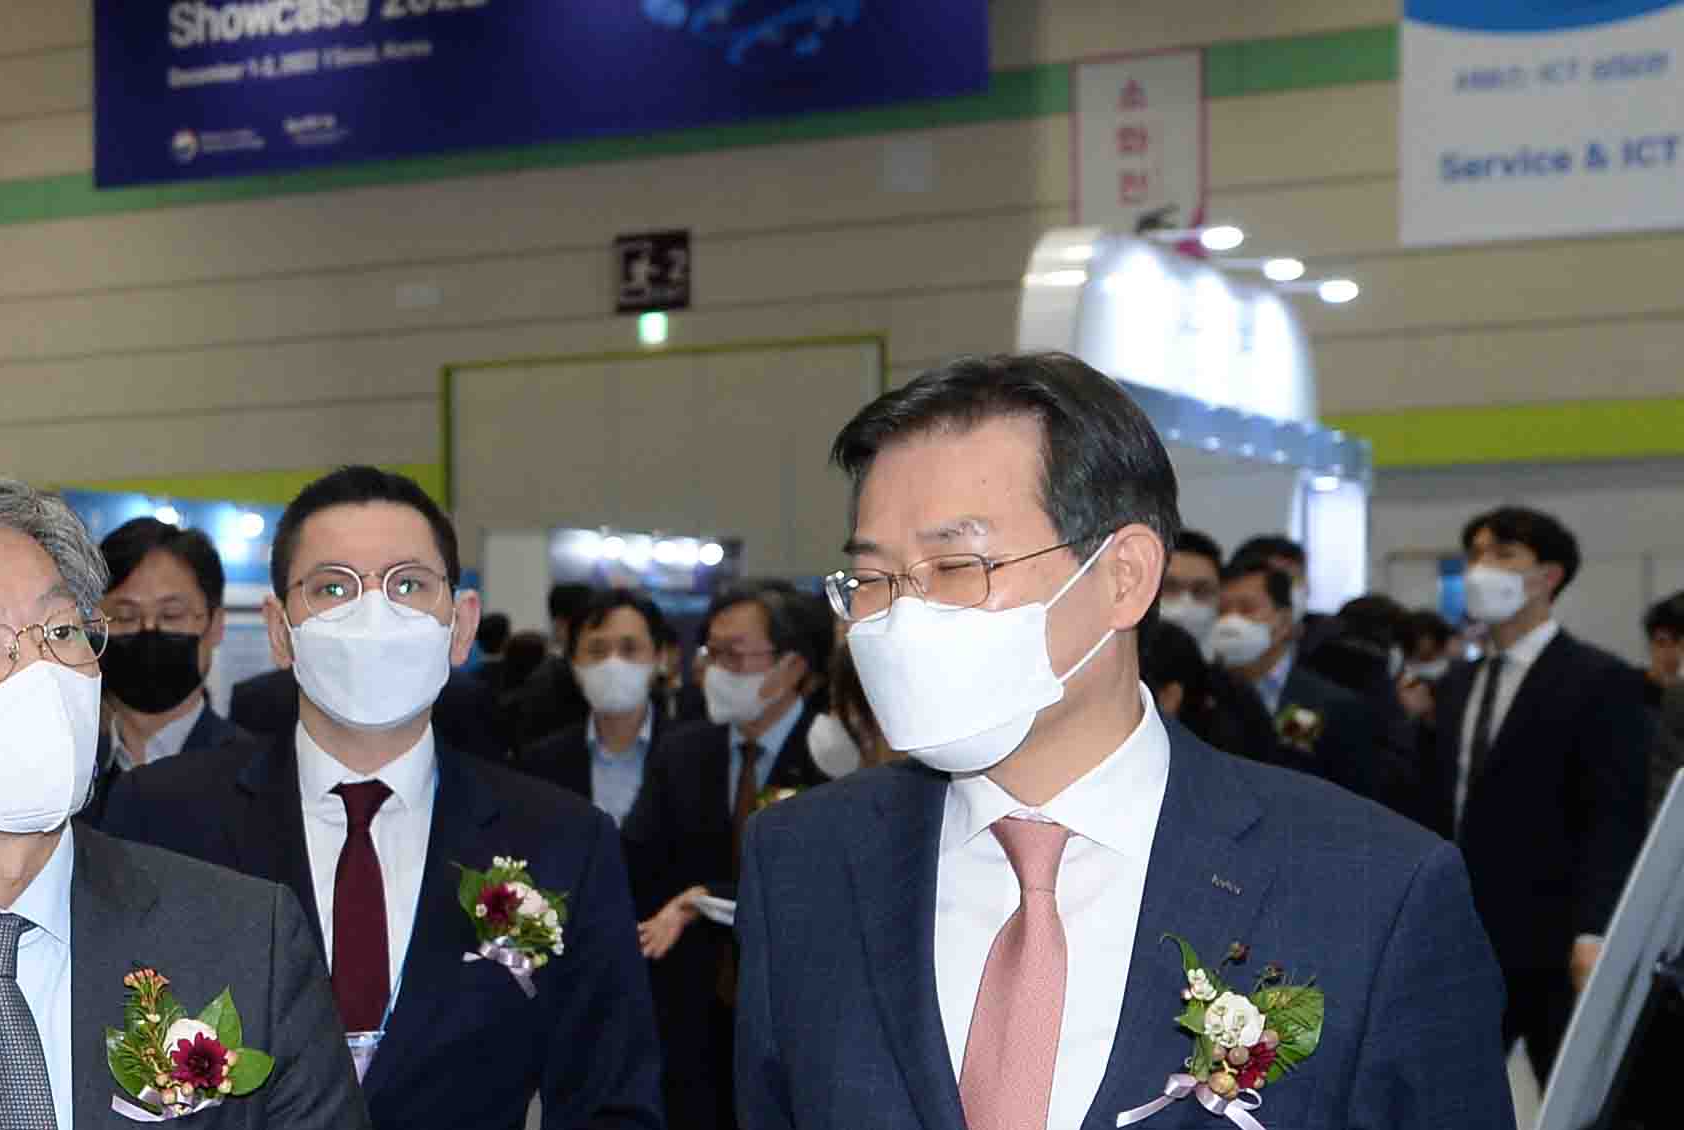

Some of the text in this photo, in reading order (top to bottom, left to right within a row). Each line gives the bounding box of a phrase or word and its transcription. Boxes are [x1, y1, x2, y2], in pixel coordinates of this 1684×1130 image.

[1439, 134, 1680, 184] Service & ICT
